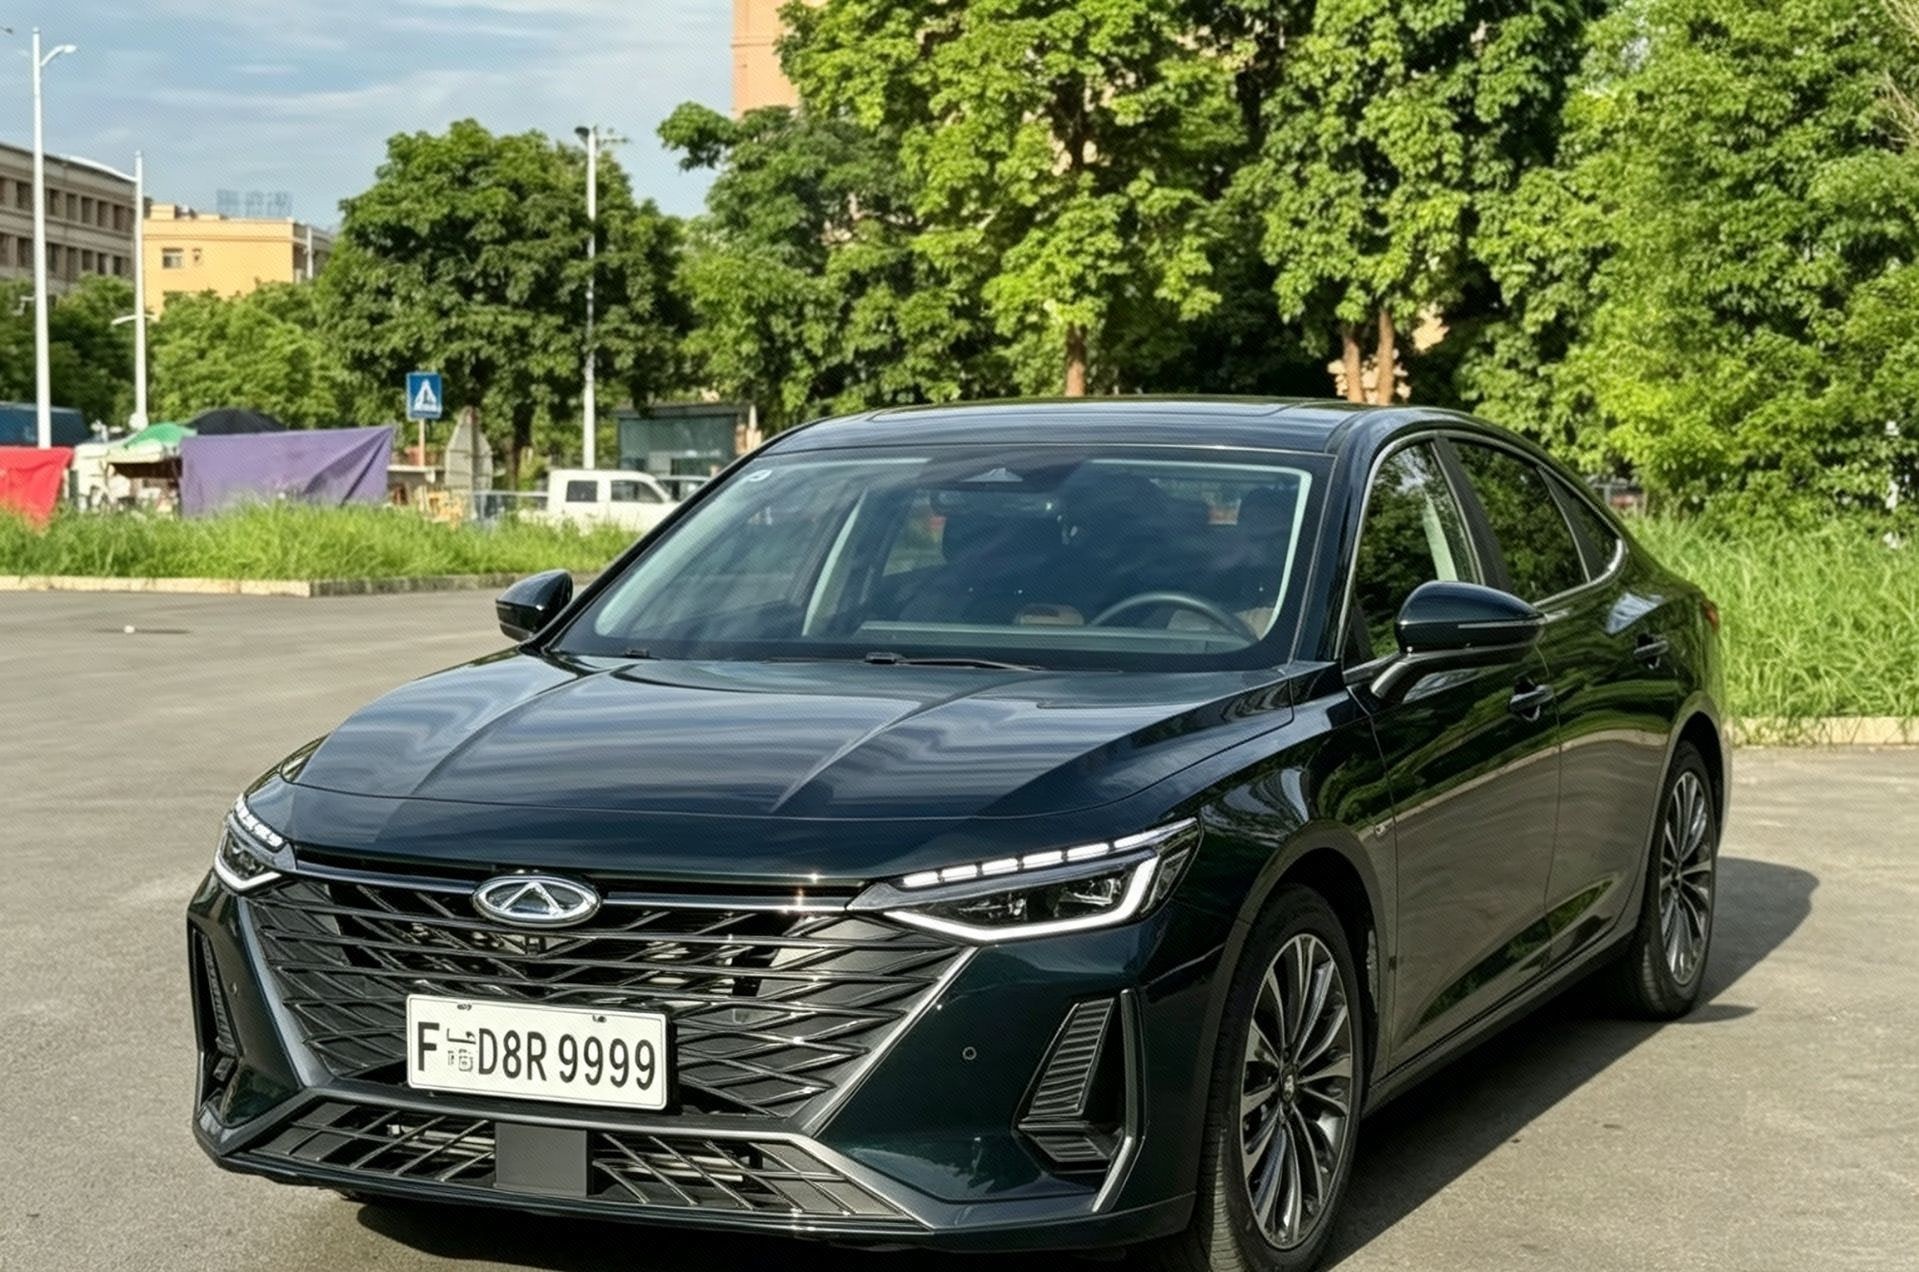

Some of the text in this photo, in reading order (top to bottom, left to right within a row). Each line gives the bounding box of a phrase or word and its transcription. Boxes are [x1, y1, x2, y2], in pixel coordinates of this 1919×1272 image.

[418, 1021, 440, 1072] F
[478, 1027, 547, 1081] D8R
[558, 1033, 655, 1090] 9999
